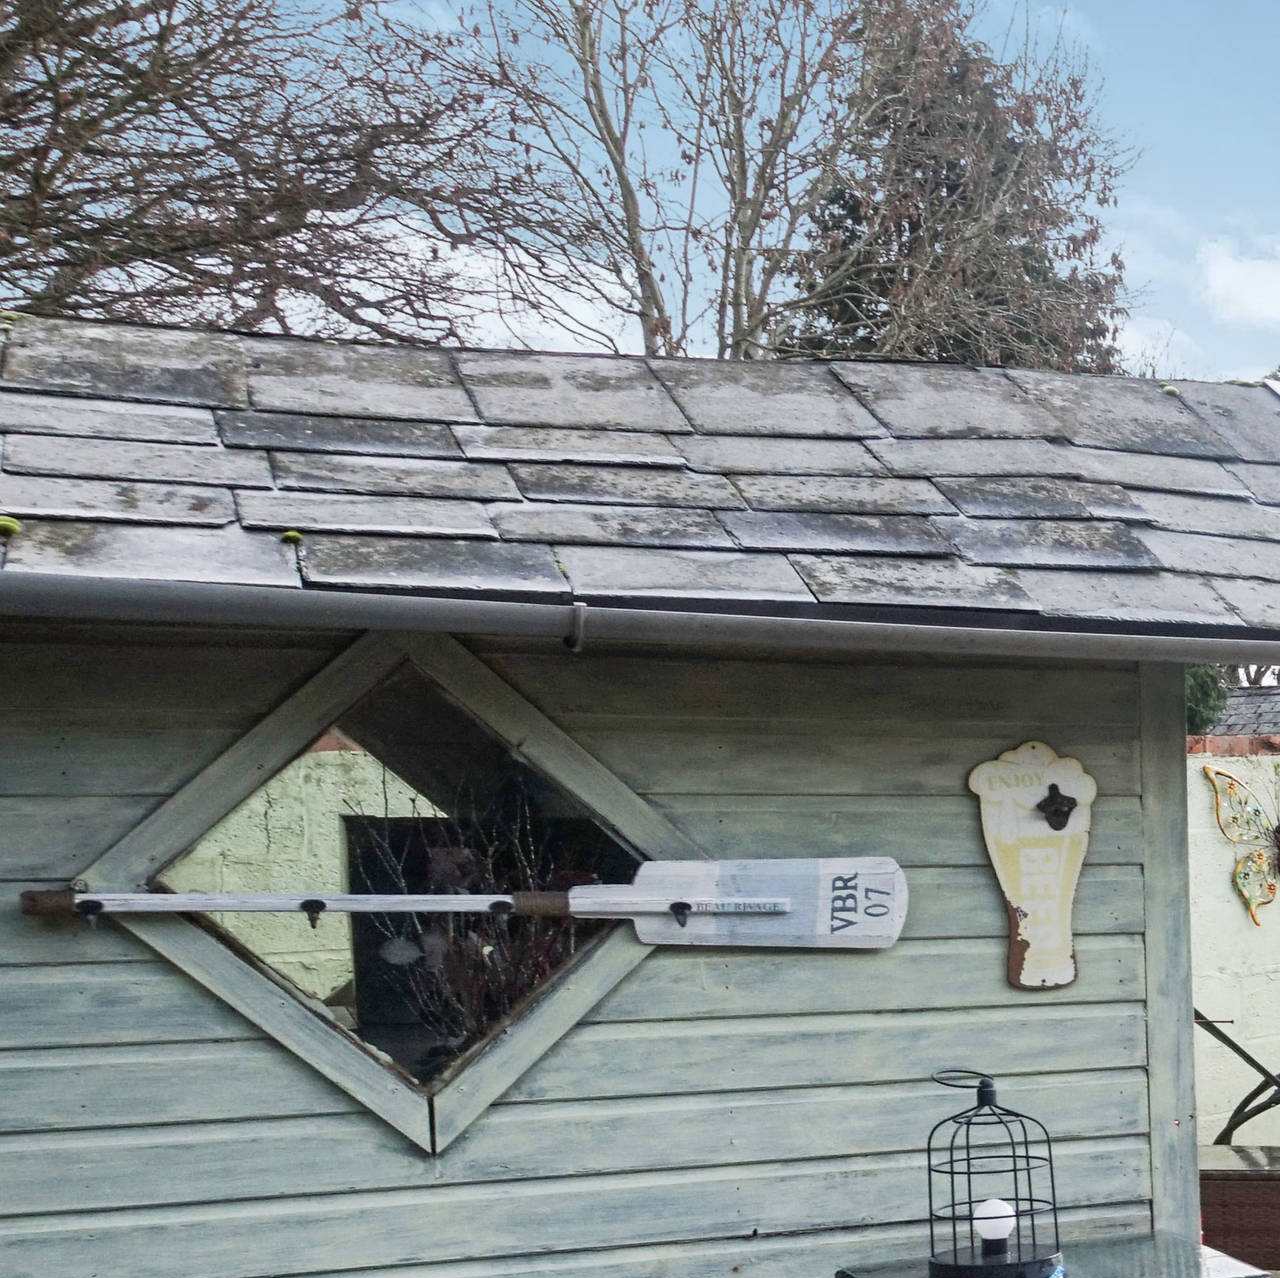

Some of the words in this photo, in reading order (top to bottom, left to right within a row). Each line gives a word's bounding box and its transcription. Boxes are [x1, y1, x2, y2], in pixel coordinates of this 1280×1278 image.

[987, 771, 1045, 792] ENJOY
[734, 902, 781, 912] RIVAGE
[831, 872, 858, 934] VBR
[864, 887, 891, 917] 07
[1020, 847, 1059, 949] BEER
